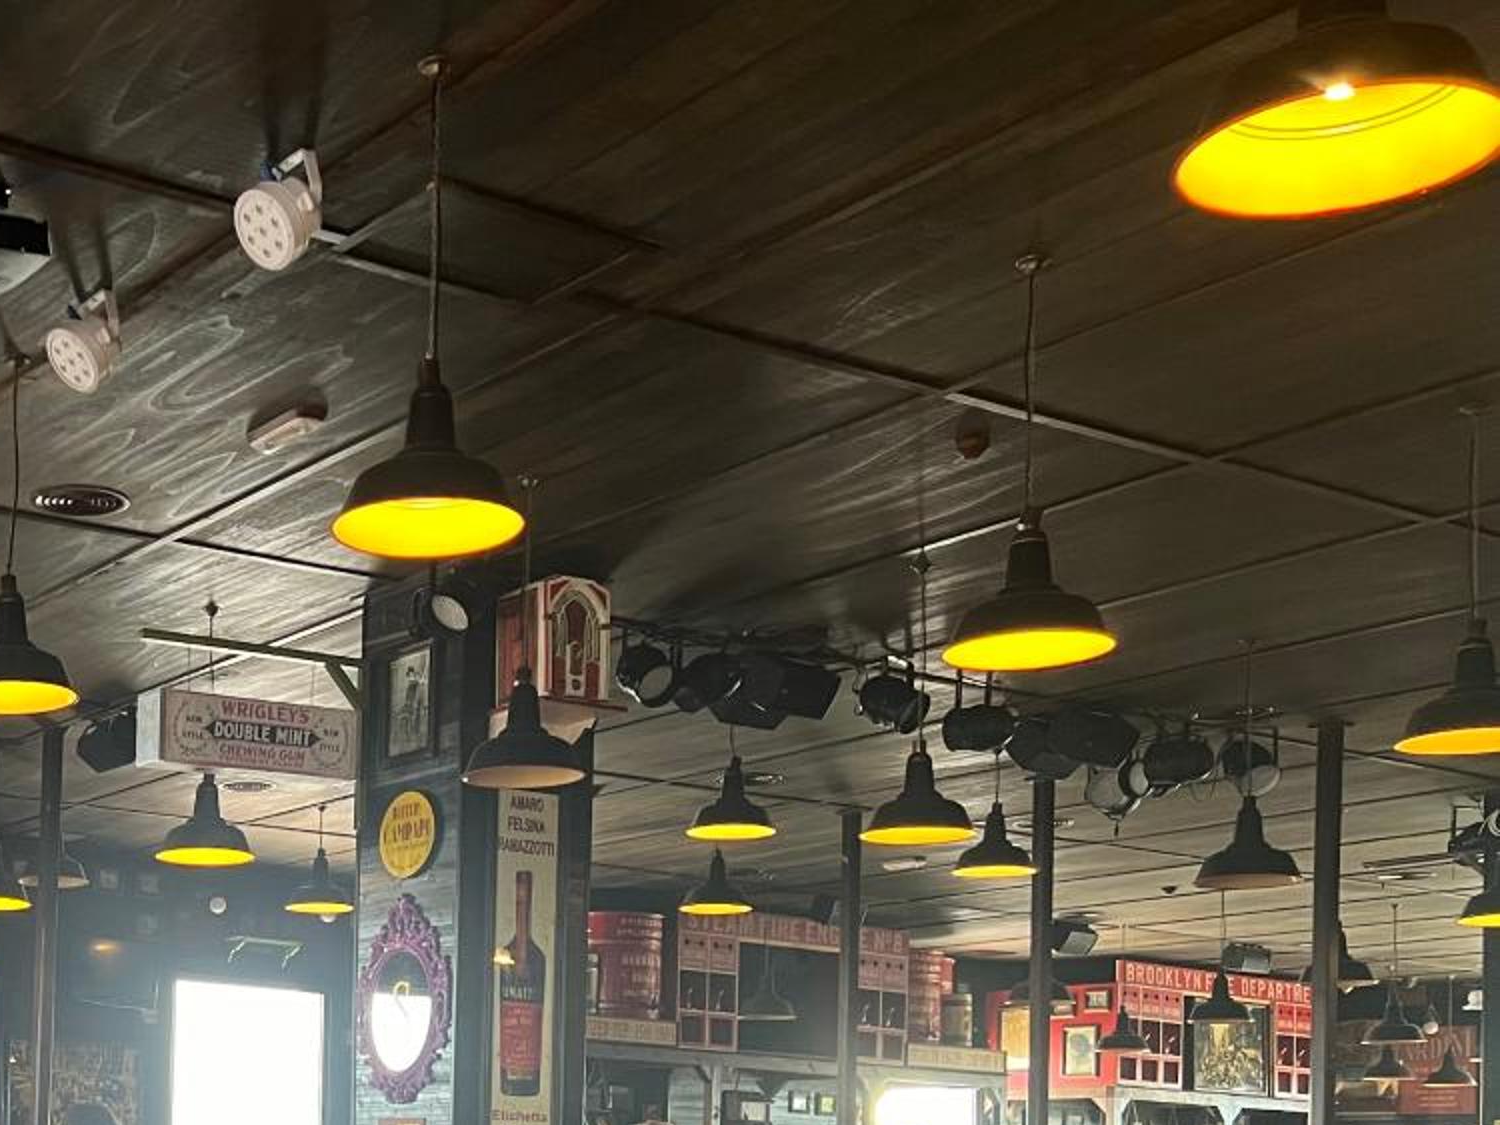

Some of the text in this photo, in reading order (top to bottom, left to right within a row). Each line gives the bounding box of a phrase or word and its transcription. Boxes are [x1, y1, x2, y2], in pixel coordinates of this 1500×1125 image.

[214, 721, 310, 746] DOUBLE MINT
[219, 743, 276, 760] CHEWING
[279, 749, 305, 764] GUM
[510, 796, 544, 812] AMARO
[508, 815, 544, 833] FELSINA
[1126, 963, 1312, 1003] BROOKLYN FE DEPARTME
